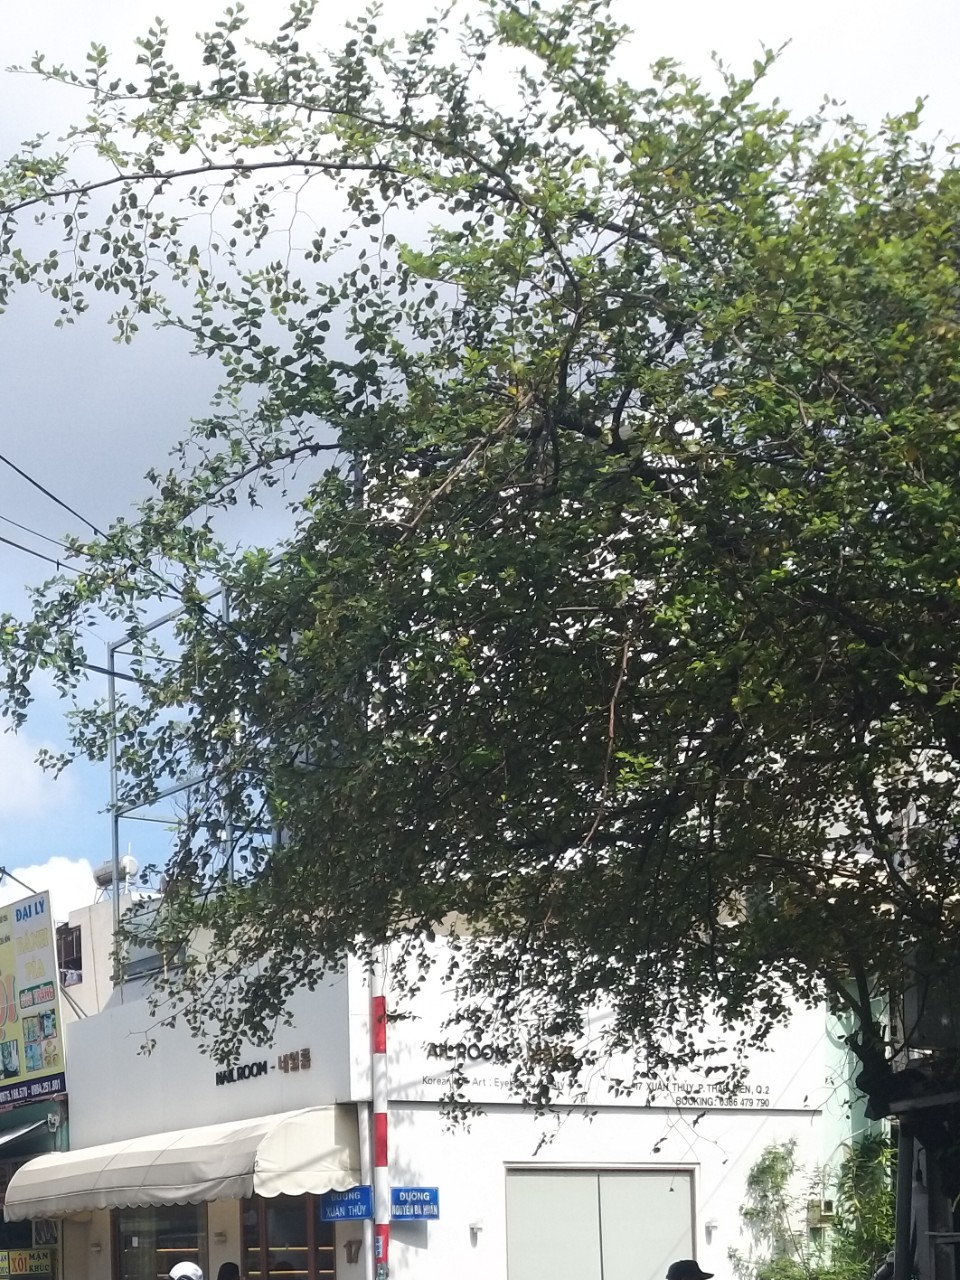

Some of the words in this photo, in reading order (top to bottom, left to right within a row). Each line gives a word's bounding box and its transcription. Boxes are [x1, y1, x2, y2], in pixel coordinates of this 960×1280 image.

[15, 906, 32, 922] ĐẠI
[35, 899, 45, 914] LÝ
[278, 1048, 311, 1073] 네일룸
[427, 1042, 455, 1061] AIL
[216, 1067, 236, 1086] NAIL
[237, 1060, 268, 1080] ROOM
[472, 1078, 486, 1087] Art
[676, 1097, 716, 1106] BOOKING:
[740, 1098, 753, 1107] 479
[756, 1099, 770, 1107] 790
[400, 1190, 430, 1201] ĐƯỜNG
[326, 1205, 345, 1218] XUÂN
[348, 1202, 366, 1217] THỦY
[344, 1239, 362, 1264] 17
[11, 1252, 27, 1273] XÔI
